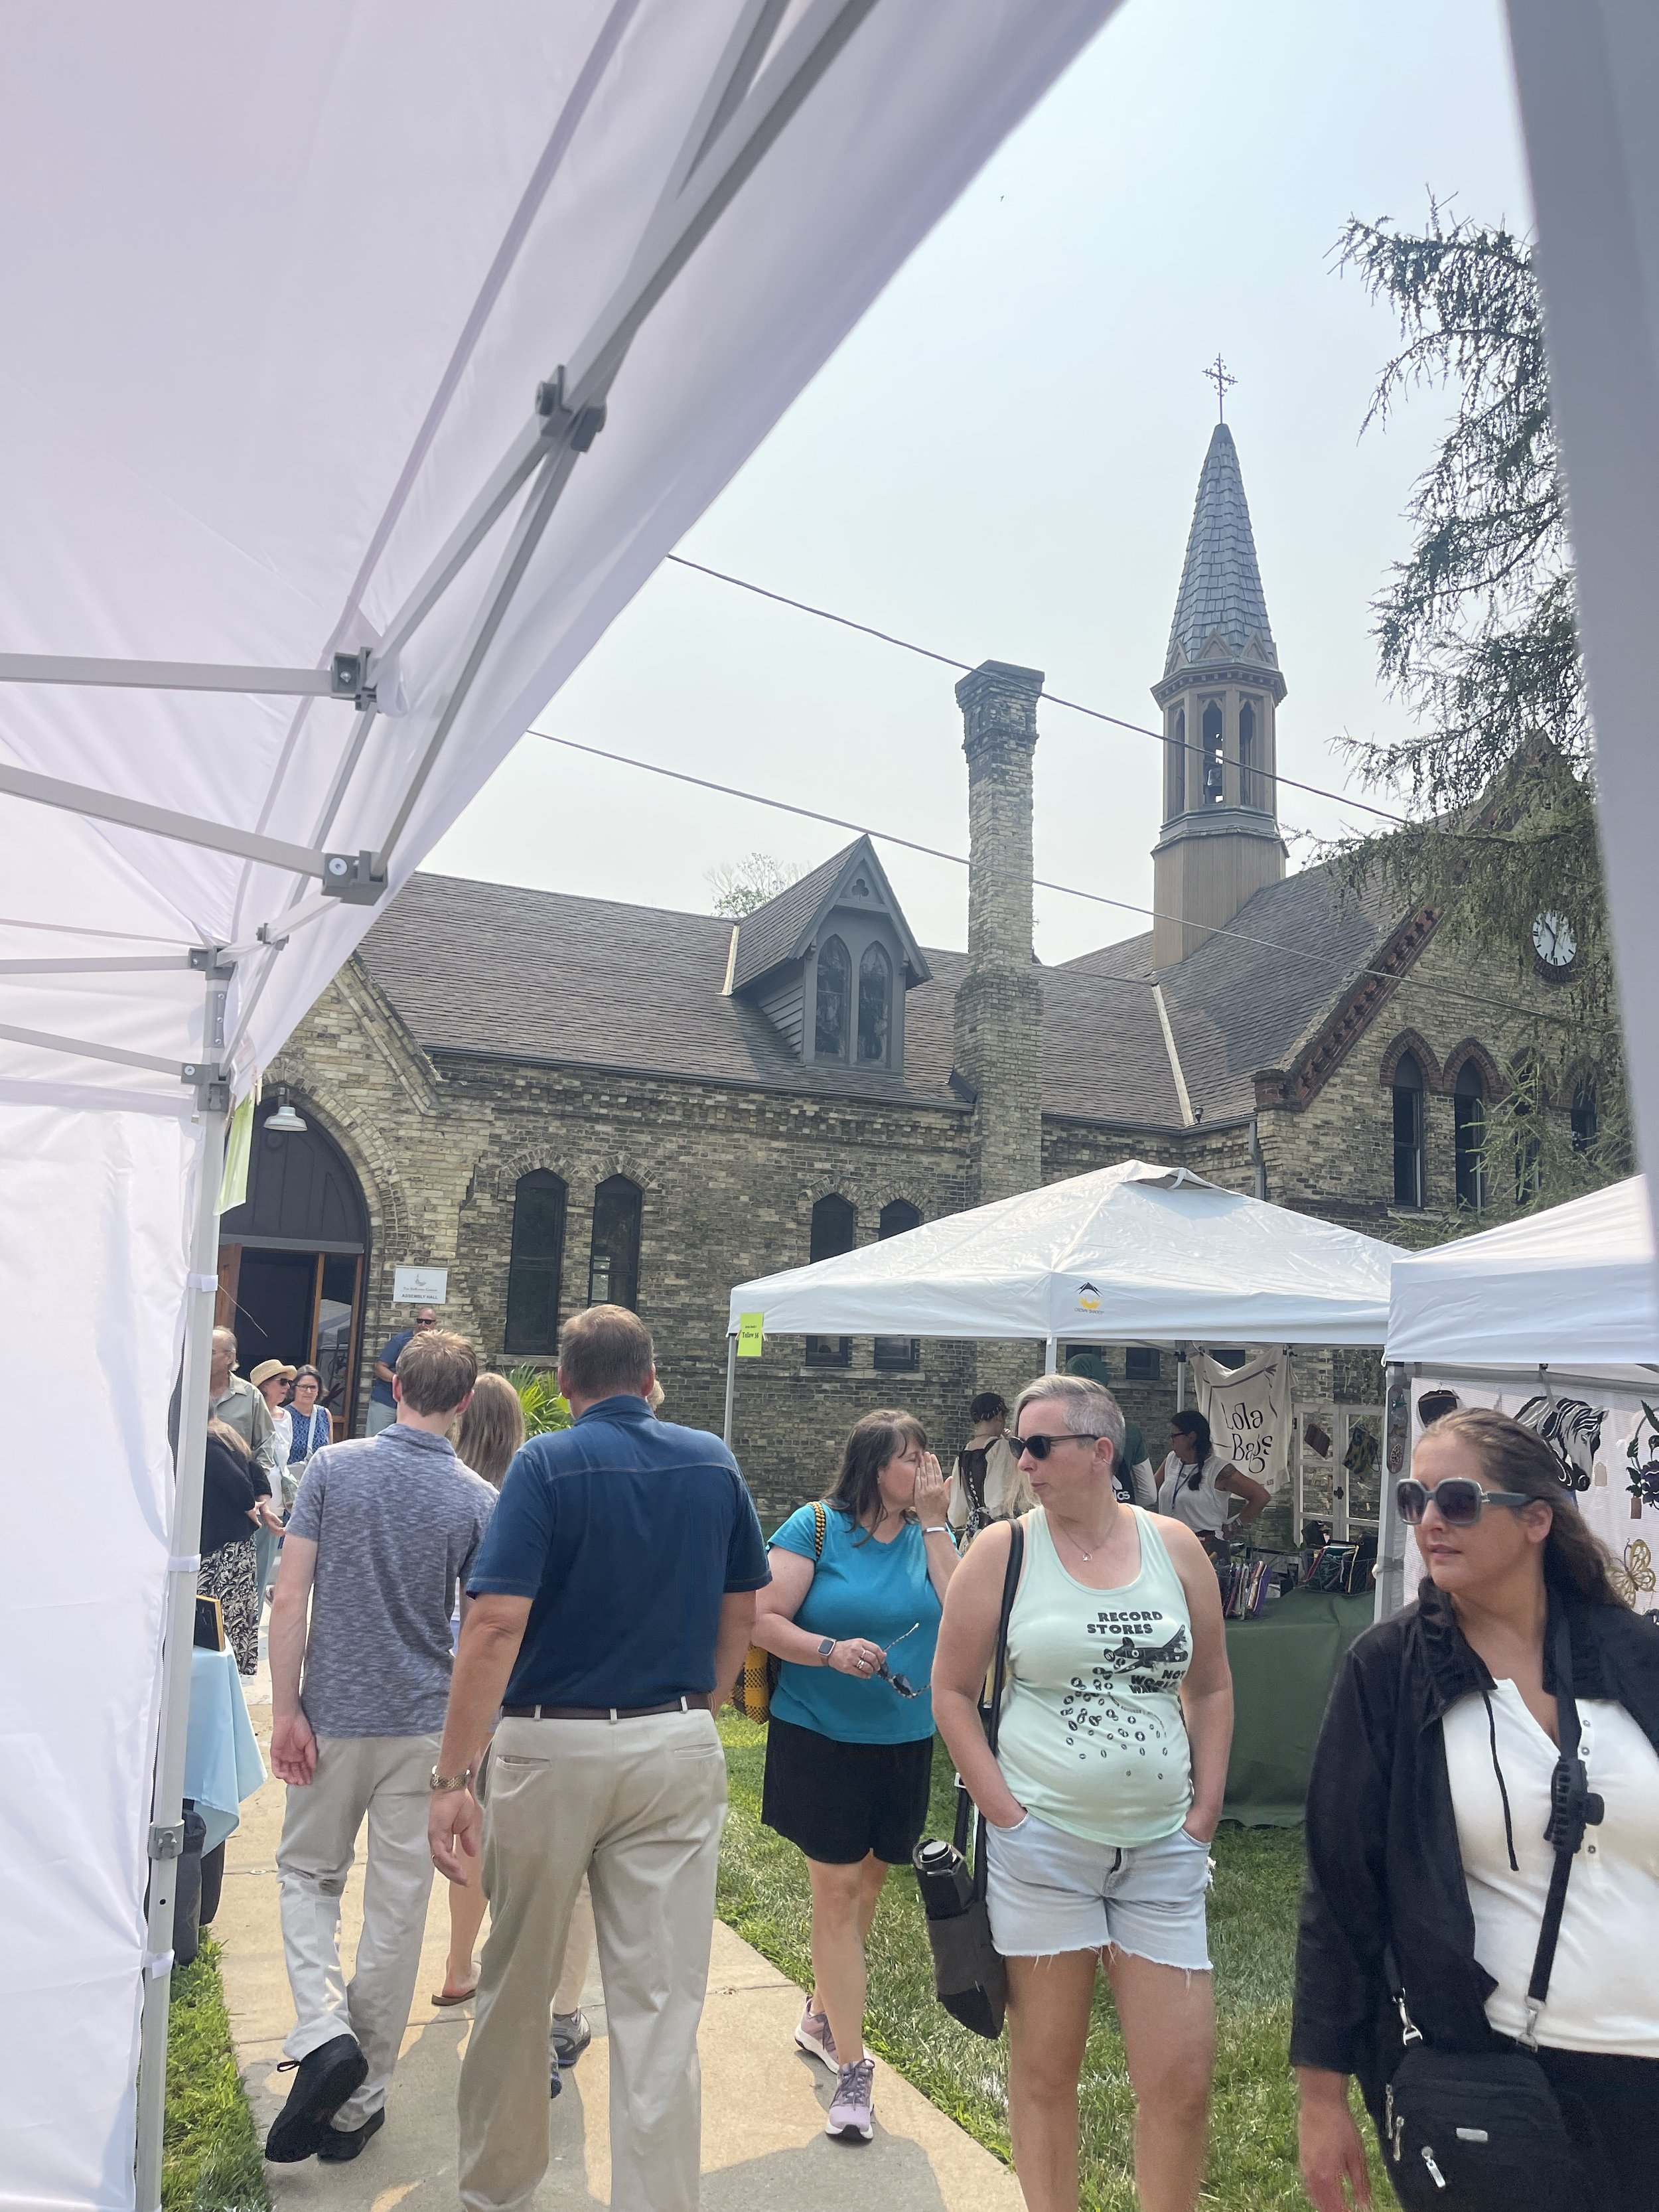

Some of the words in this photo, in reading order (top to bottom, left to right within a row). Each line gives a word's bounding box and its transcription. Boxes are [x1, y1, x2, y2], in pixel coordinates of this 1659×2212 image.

[1221, 1402, 1263, 1430] Lola
[1232, 1434, 1273, 1473] Bags
[1098, 1611, 1163, 1622] RECORD
[1087, 1623, 1153, 1635] STORES
